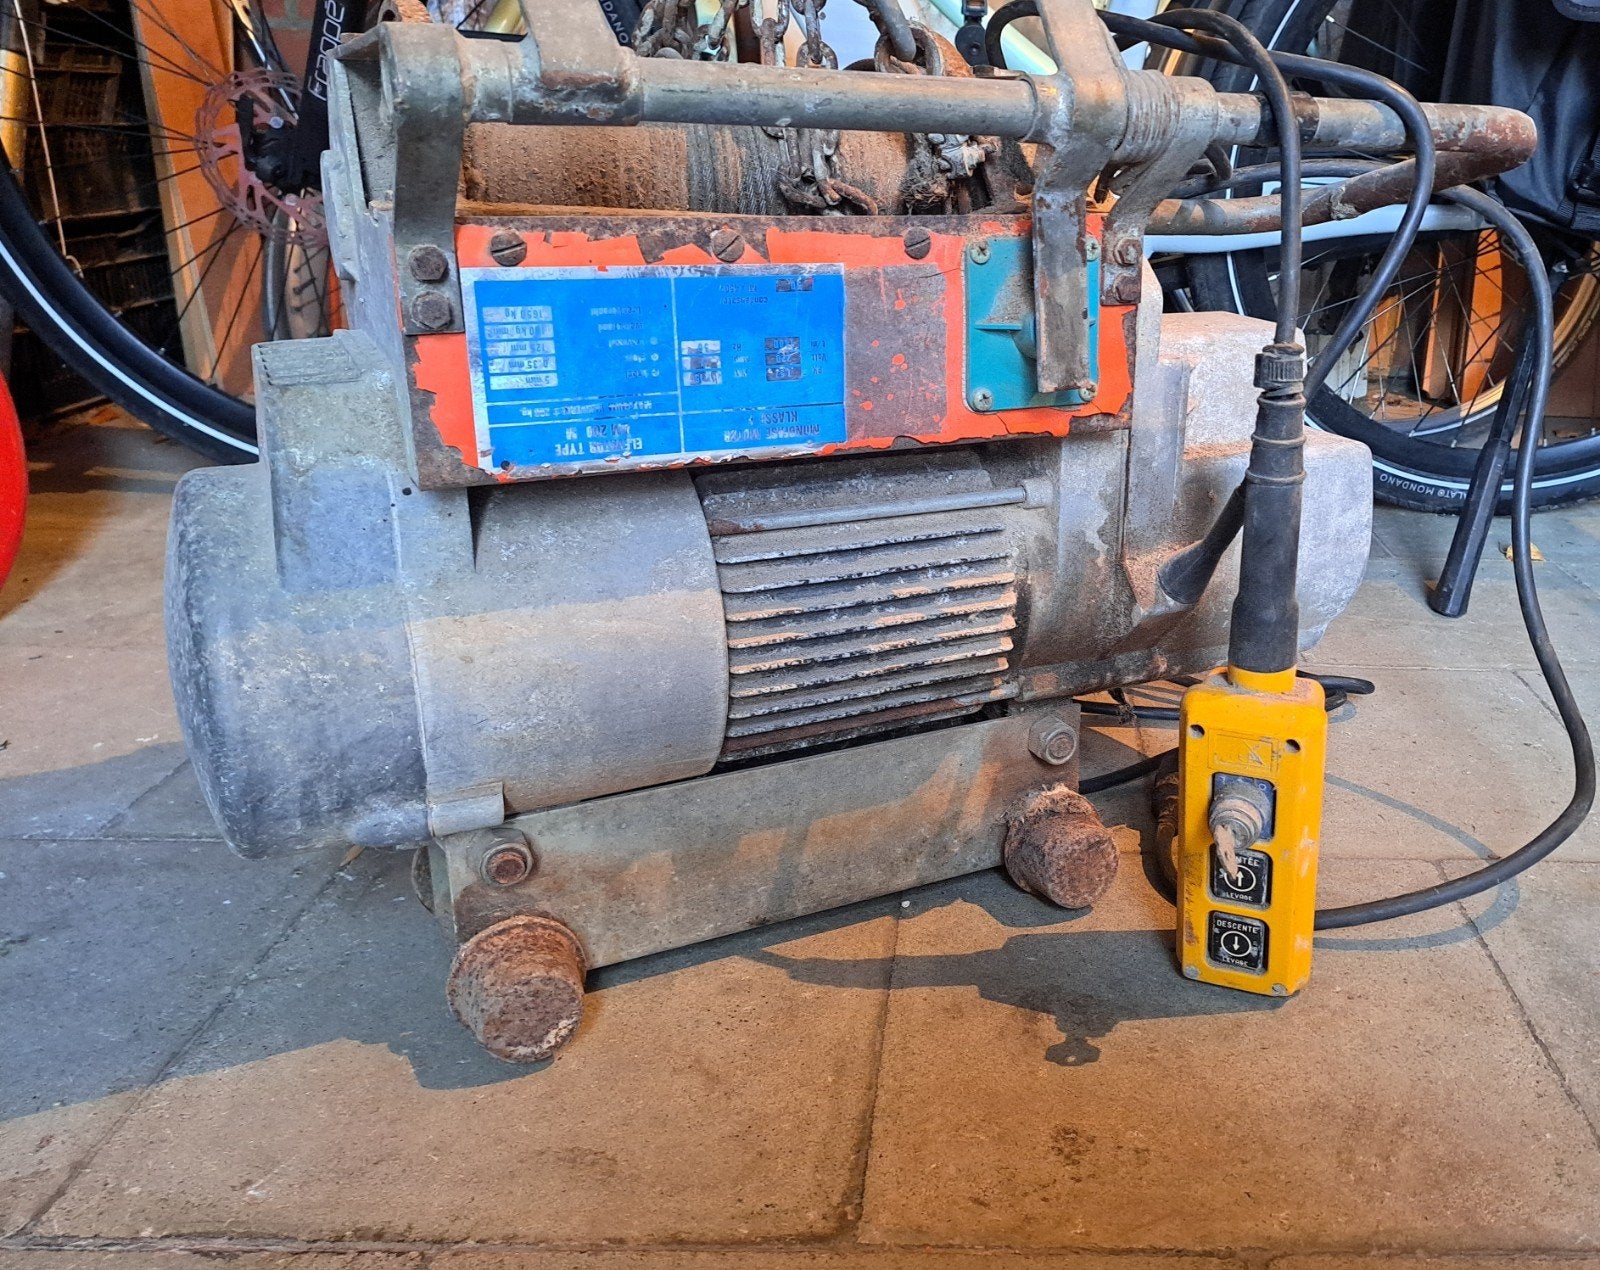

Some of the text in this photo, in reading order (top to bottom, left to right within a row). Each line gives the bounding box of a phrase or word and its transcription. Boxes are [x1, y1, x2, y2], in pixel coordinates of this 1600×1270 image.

[600, 0, 630, 44] DANO
[504, 307, 517, 320] kg
[529, 326, 545, 336] 10
[554, 441, 585, 456] TYPE
[1379, 473, 1435, 496] MONDANO
[1216, 919, 1259, 934] DESCENTE
